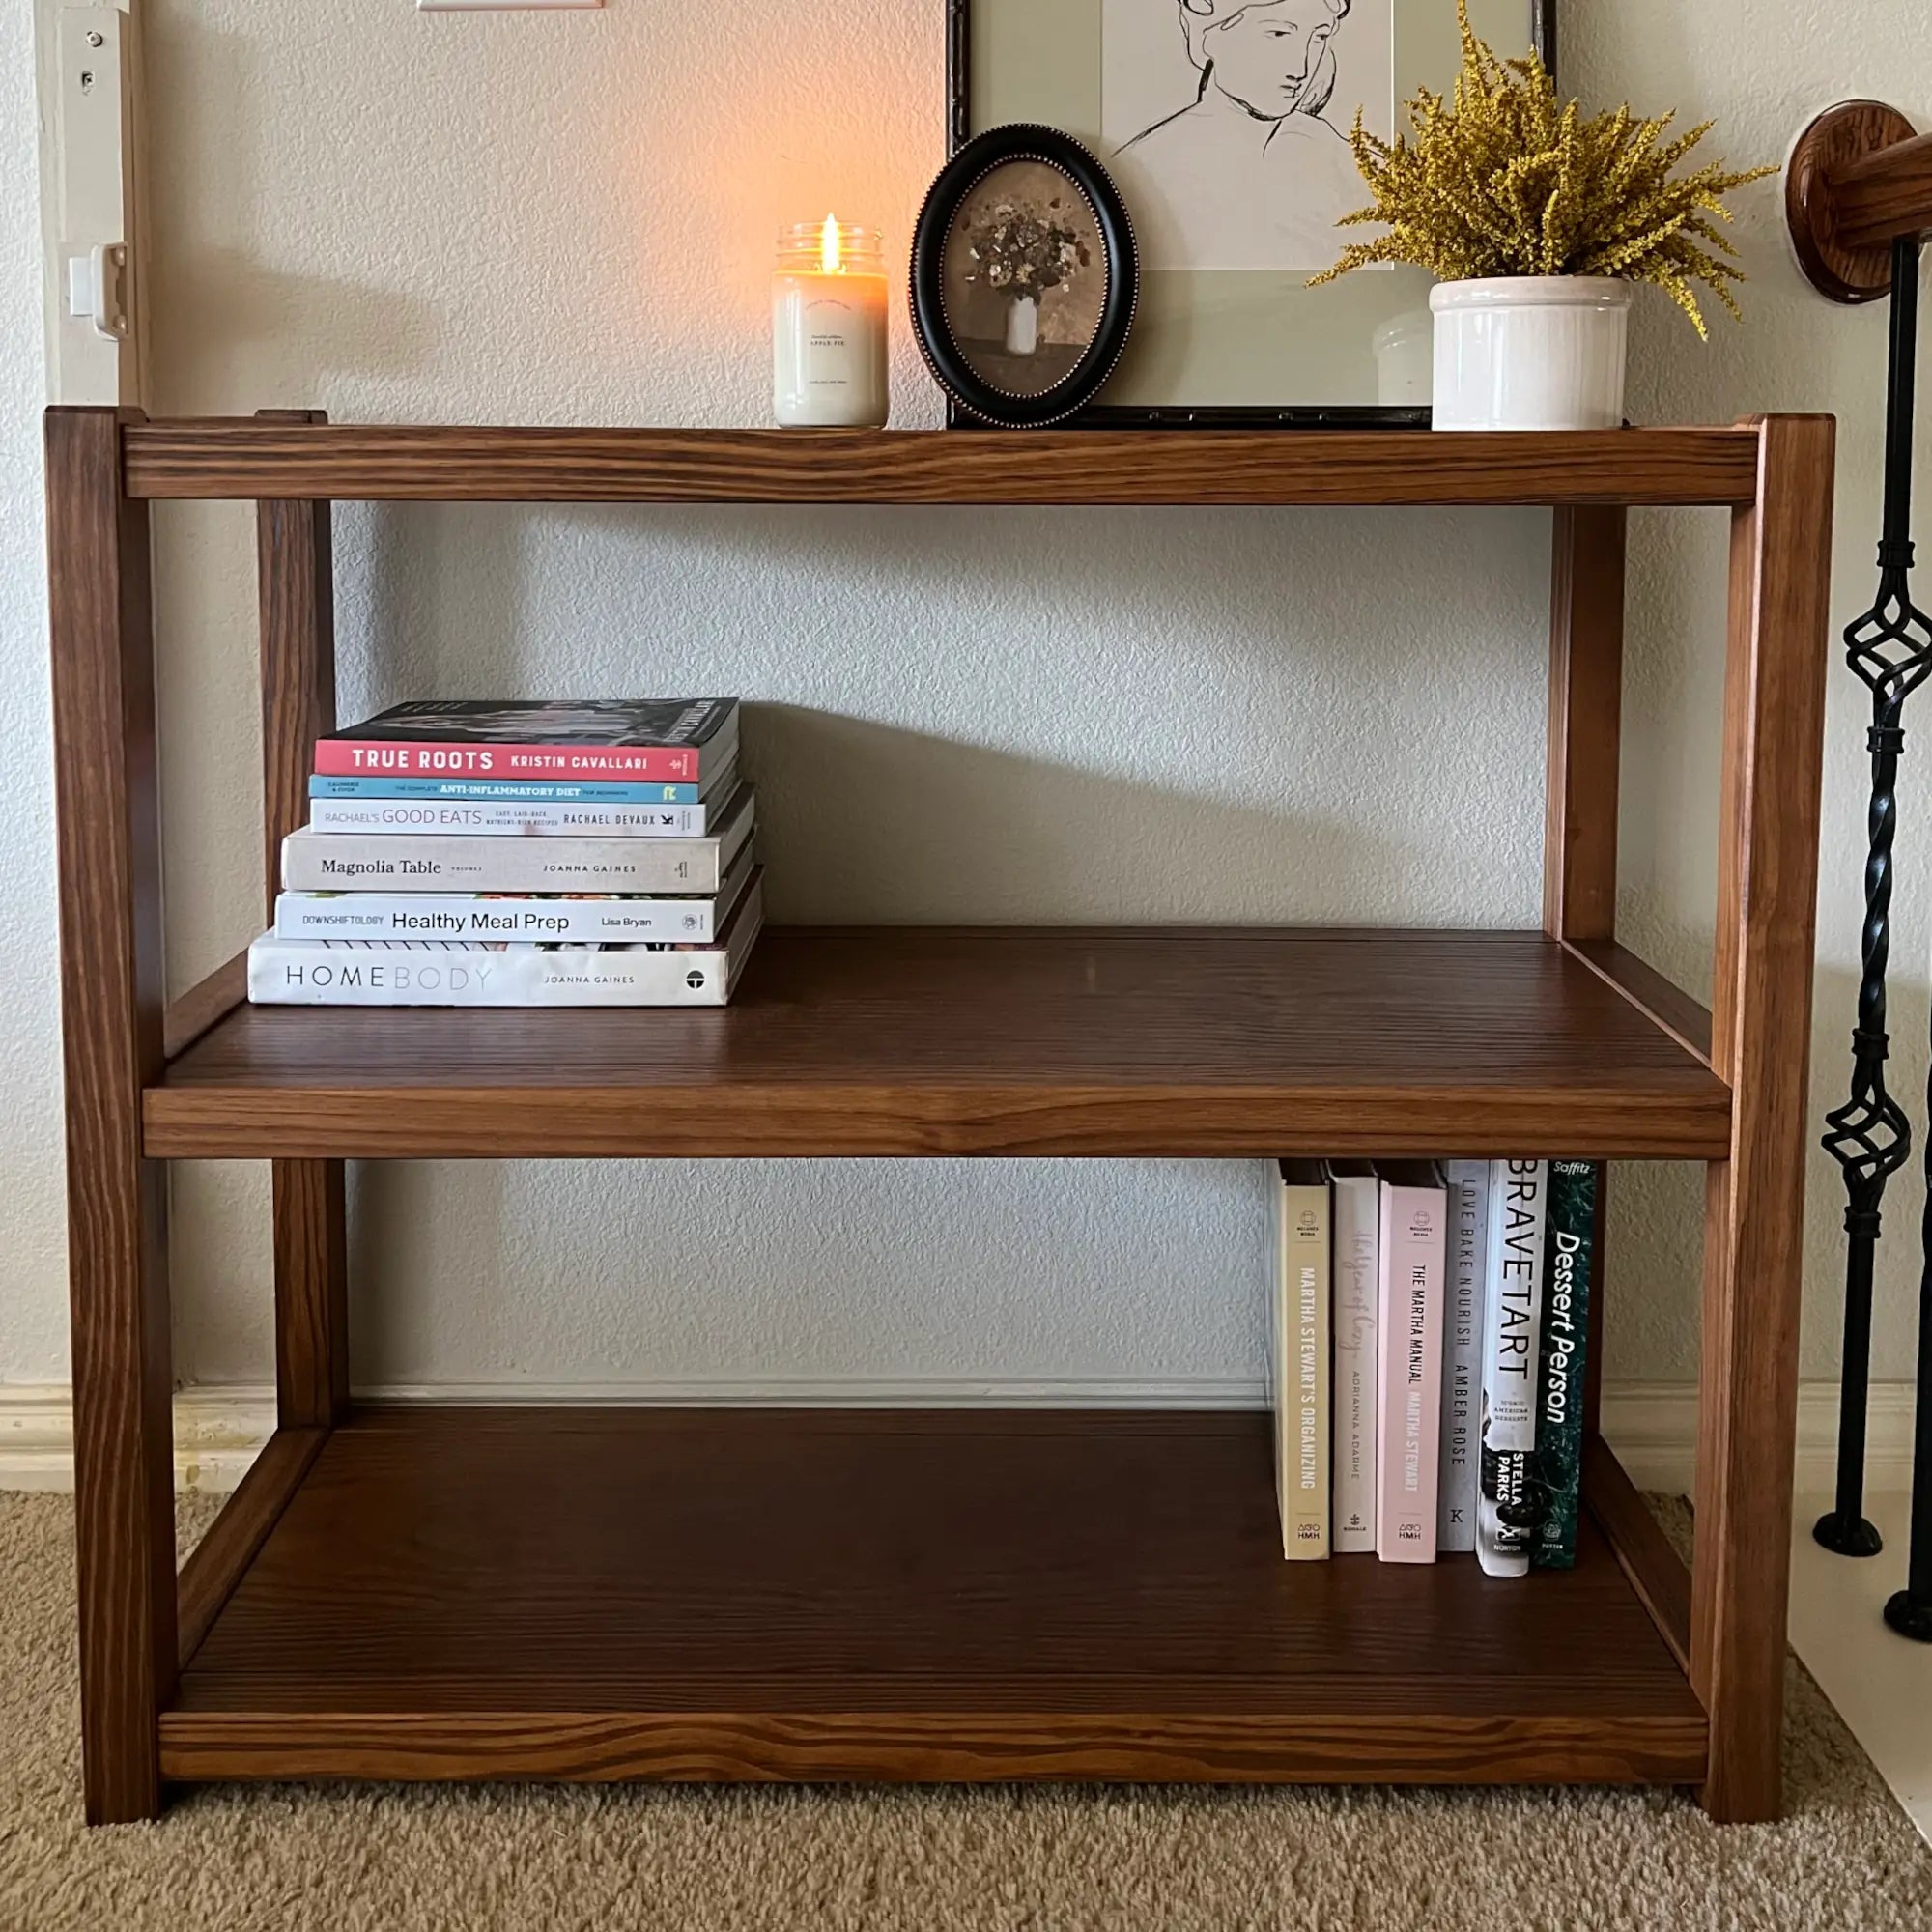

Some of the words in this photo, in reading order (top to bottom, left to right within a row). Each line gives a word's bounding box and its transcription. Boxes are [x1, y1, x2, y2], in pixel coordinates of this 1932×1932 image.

[352, 749, 410, 769] TRUE
[418, 750, 494, 770] ROOTS
[510, 755, 565, 768] KRISTIN
[571, 756, 647, 770] CAVALLARI
[440, 784, 554, 796] ANTI-INFLAMMATORY
[555, 787, 581, 797] DIET
[325, 812, 380, 823] RACHAEL'S
[382, 809, 435, 824] GOOD
[440, 810, 482, 825] EATS
[563, 813, 610, 825] RACHAEL
[615, 814, 656, 826] DEVAUX
[321, 859, 394, 876] Magnolia
[399, 860, 441, 874] Table
[593, 865, 637, 873] GAINES
[302, 915, 384, 925] DOWNSHIFTOLOGY
[392, 912, 467, 933] Healthy
[471, 913, 518, 930] Meal
[524, 913, 570, 934] Prep
[602, 917, 621, 926] Lisa
[623, 918, 652, 929] Bryan
[287, 965, 493, 991] HOMEBODY
[545, 976, 590, 984] JOANNA
[594, 976, 635, 984] GAINES
[1553, 1161, 1591, 1176] Saffitz
[1461, 1179, 1476, 1220] LOVE
[1459, 1228, 1474, 1268] BAKE
[1299, 1267, 1316, 1323] MARTHA
[1412, 1264, 1426, 1286] THE
[1551, 1230, 1581, 1332] Dessert
[1410, 1290, 1425, 1335] MARTHA
[1456, 1277, 1473, 1347] NOURISH
[1300, 1327, 1316, 1404] STEWART'S
[1408, 1339, 1423, 1385] MANUAL
[1547, 1334, 1576, 1424] Person
[1351, 1371, 1360, 1430] ADRIANNA
[1453, 1365, 1468, 1418] AMBER
[1406, 1391, 1422, 1437] MARTHA
[1300, 1407, 1316, 1490] ORGANIZING
[1351, 1434, 1360, 1480] ADARME
[1404, 1440, 1419, 1492] STEWART
[1451, 1427, 1467, 1465] ROSE
[1496, 1456, 1511, 1502] PARKS
[1511, 1452, 1525, 1506] STELLA
[1450, 1509, 1463, 1523] K
